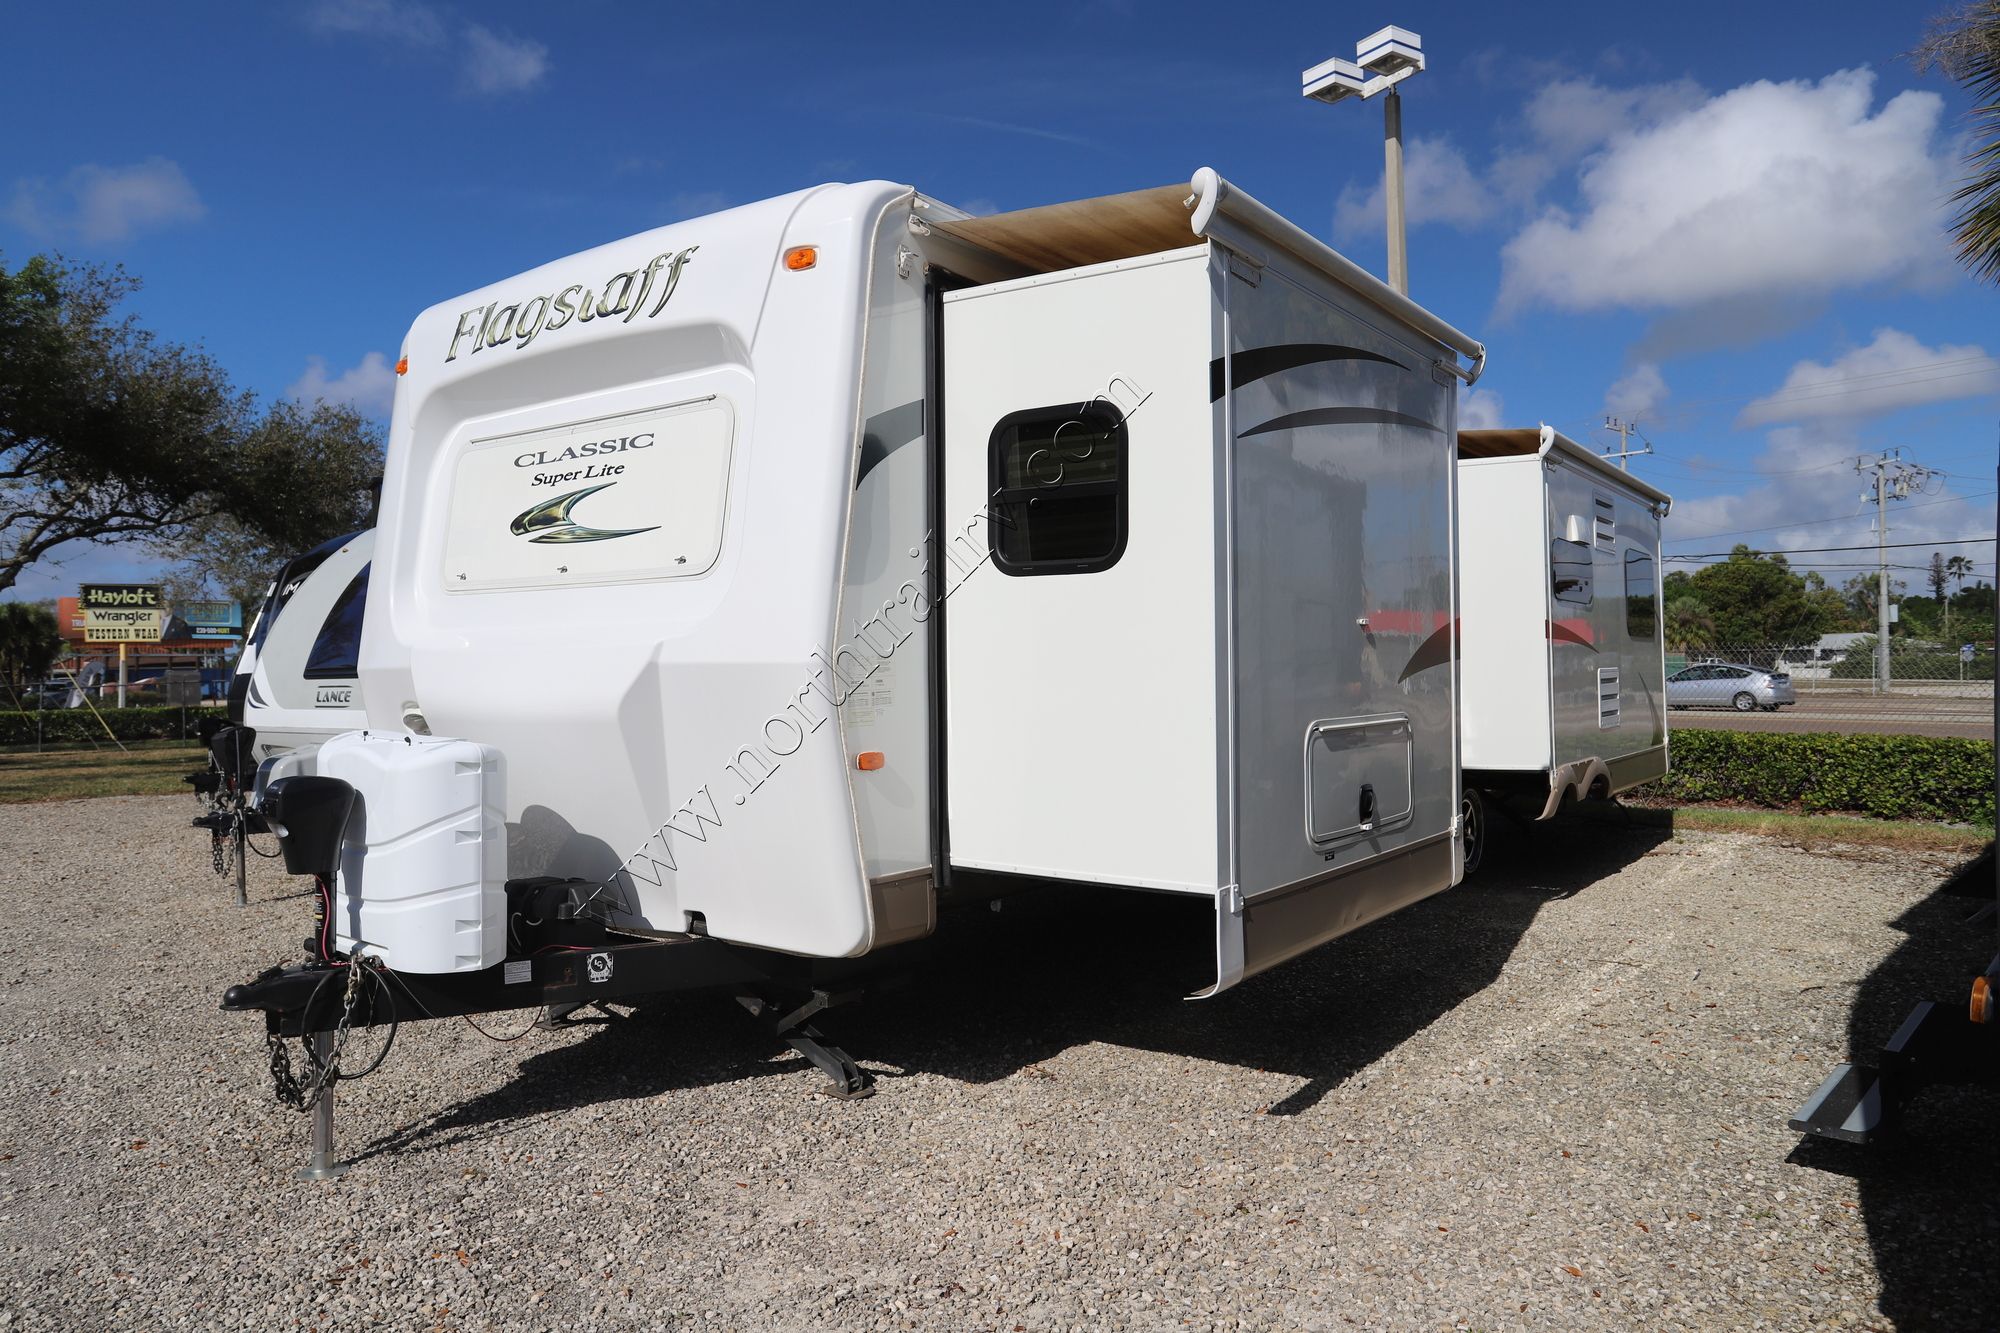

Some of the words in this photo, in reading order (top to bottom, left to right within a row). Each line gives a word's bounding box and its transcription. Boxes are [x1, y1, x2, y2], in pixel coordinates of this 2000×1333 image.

[444, 245, 700, 363] Flagstaff
[513, 432, 655, 468] CLASSIC
[530, 468, 583, 487] Super
[582, 462, 625, 479] Lite
[87, 588, 156, 606] Hayloft
[92, 610, 153, 625] Wrangler
[87, 629, 130, 639] WESTERN
[134, 628, 158, 639] WEAR
[316, 691, 351, 703] LANCE
